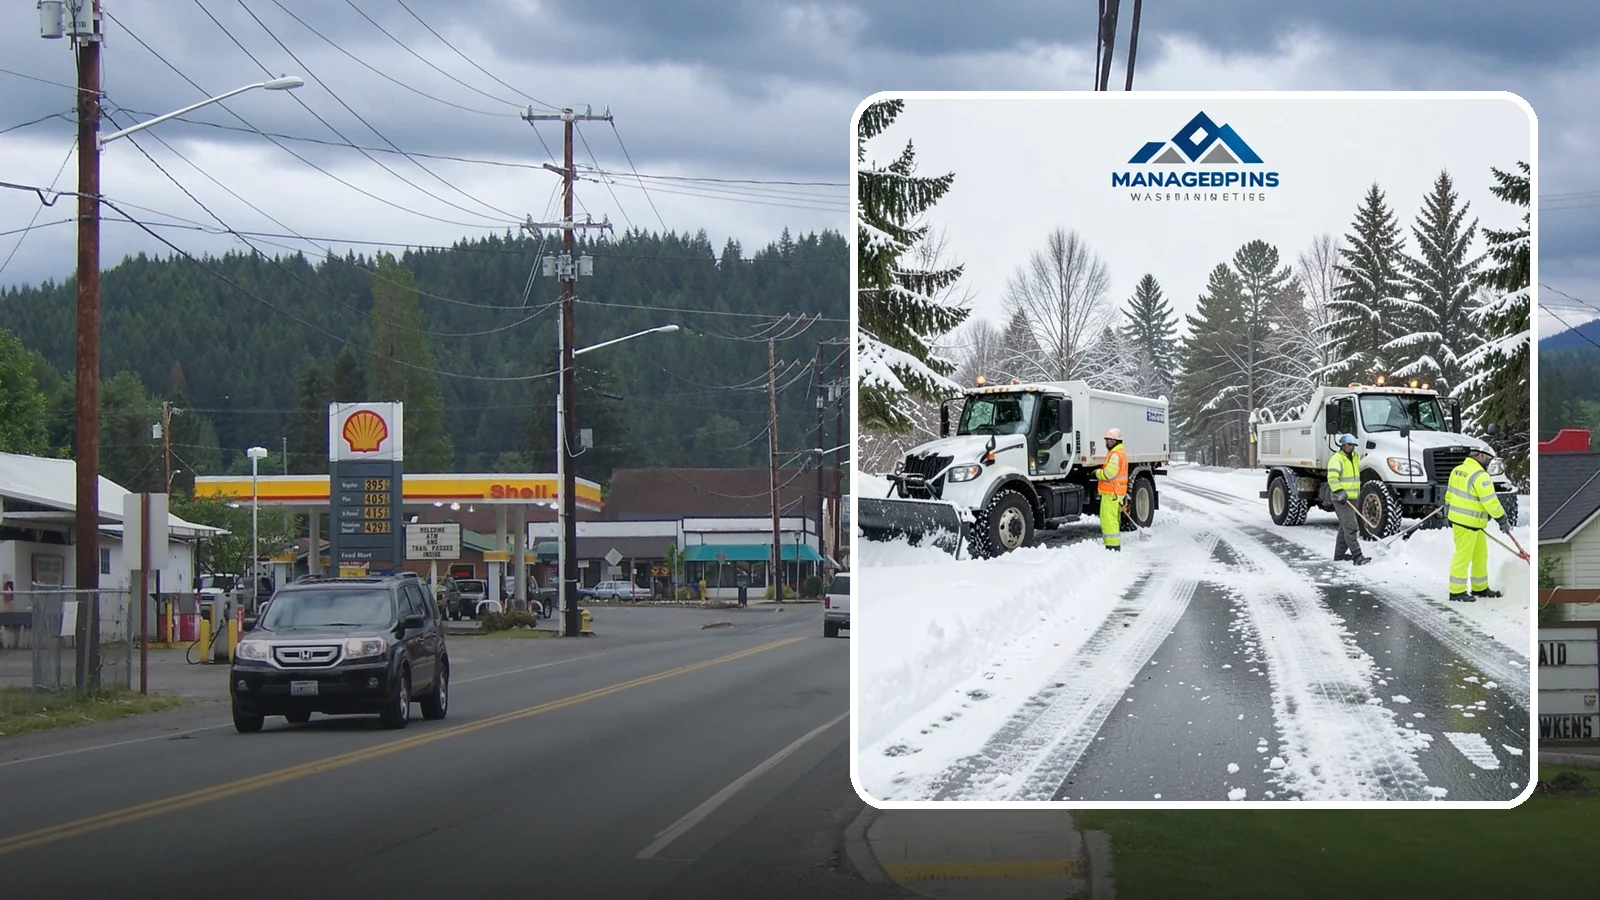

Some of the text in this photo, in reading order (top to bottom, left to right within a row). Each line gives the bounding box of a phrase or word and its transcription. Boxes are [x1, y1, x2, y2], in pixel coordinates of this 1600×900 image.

[365, 480, 383, 490] 395
[490, 484, 547, 499] Shell
[365, 494, 383, 504] 405
[365, 508, 383, 518] 415
[365, 522, 383, 532] 429
[1538, 643, 1566, 665] AID
